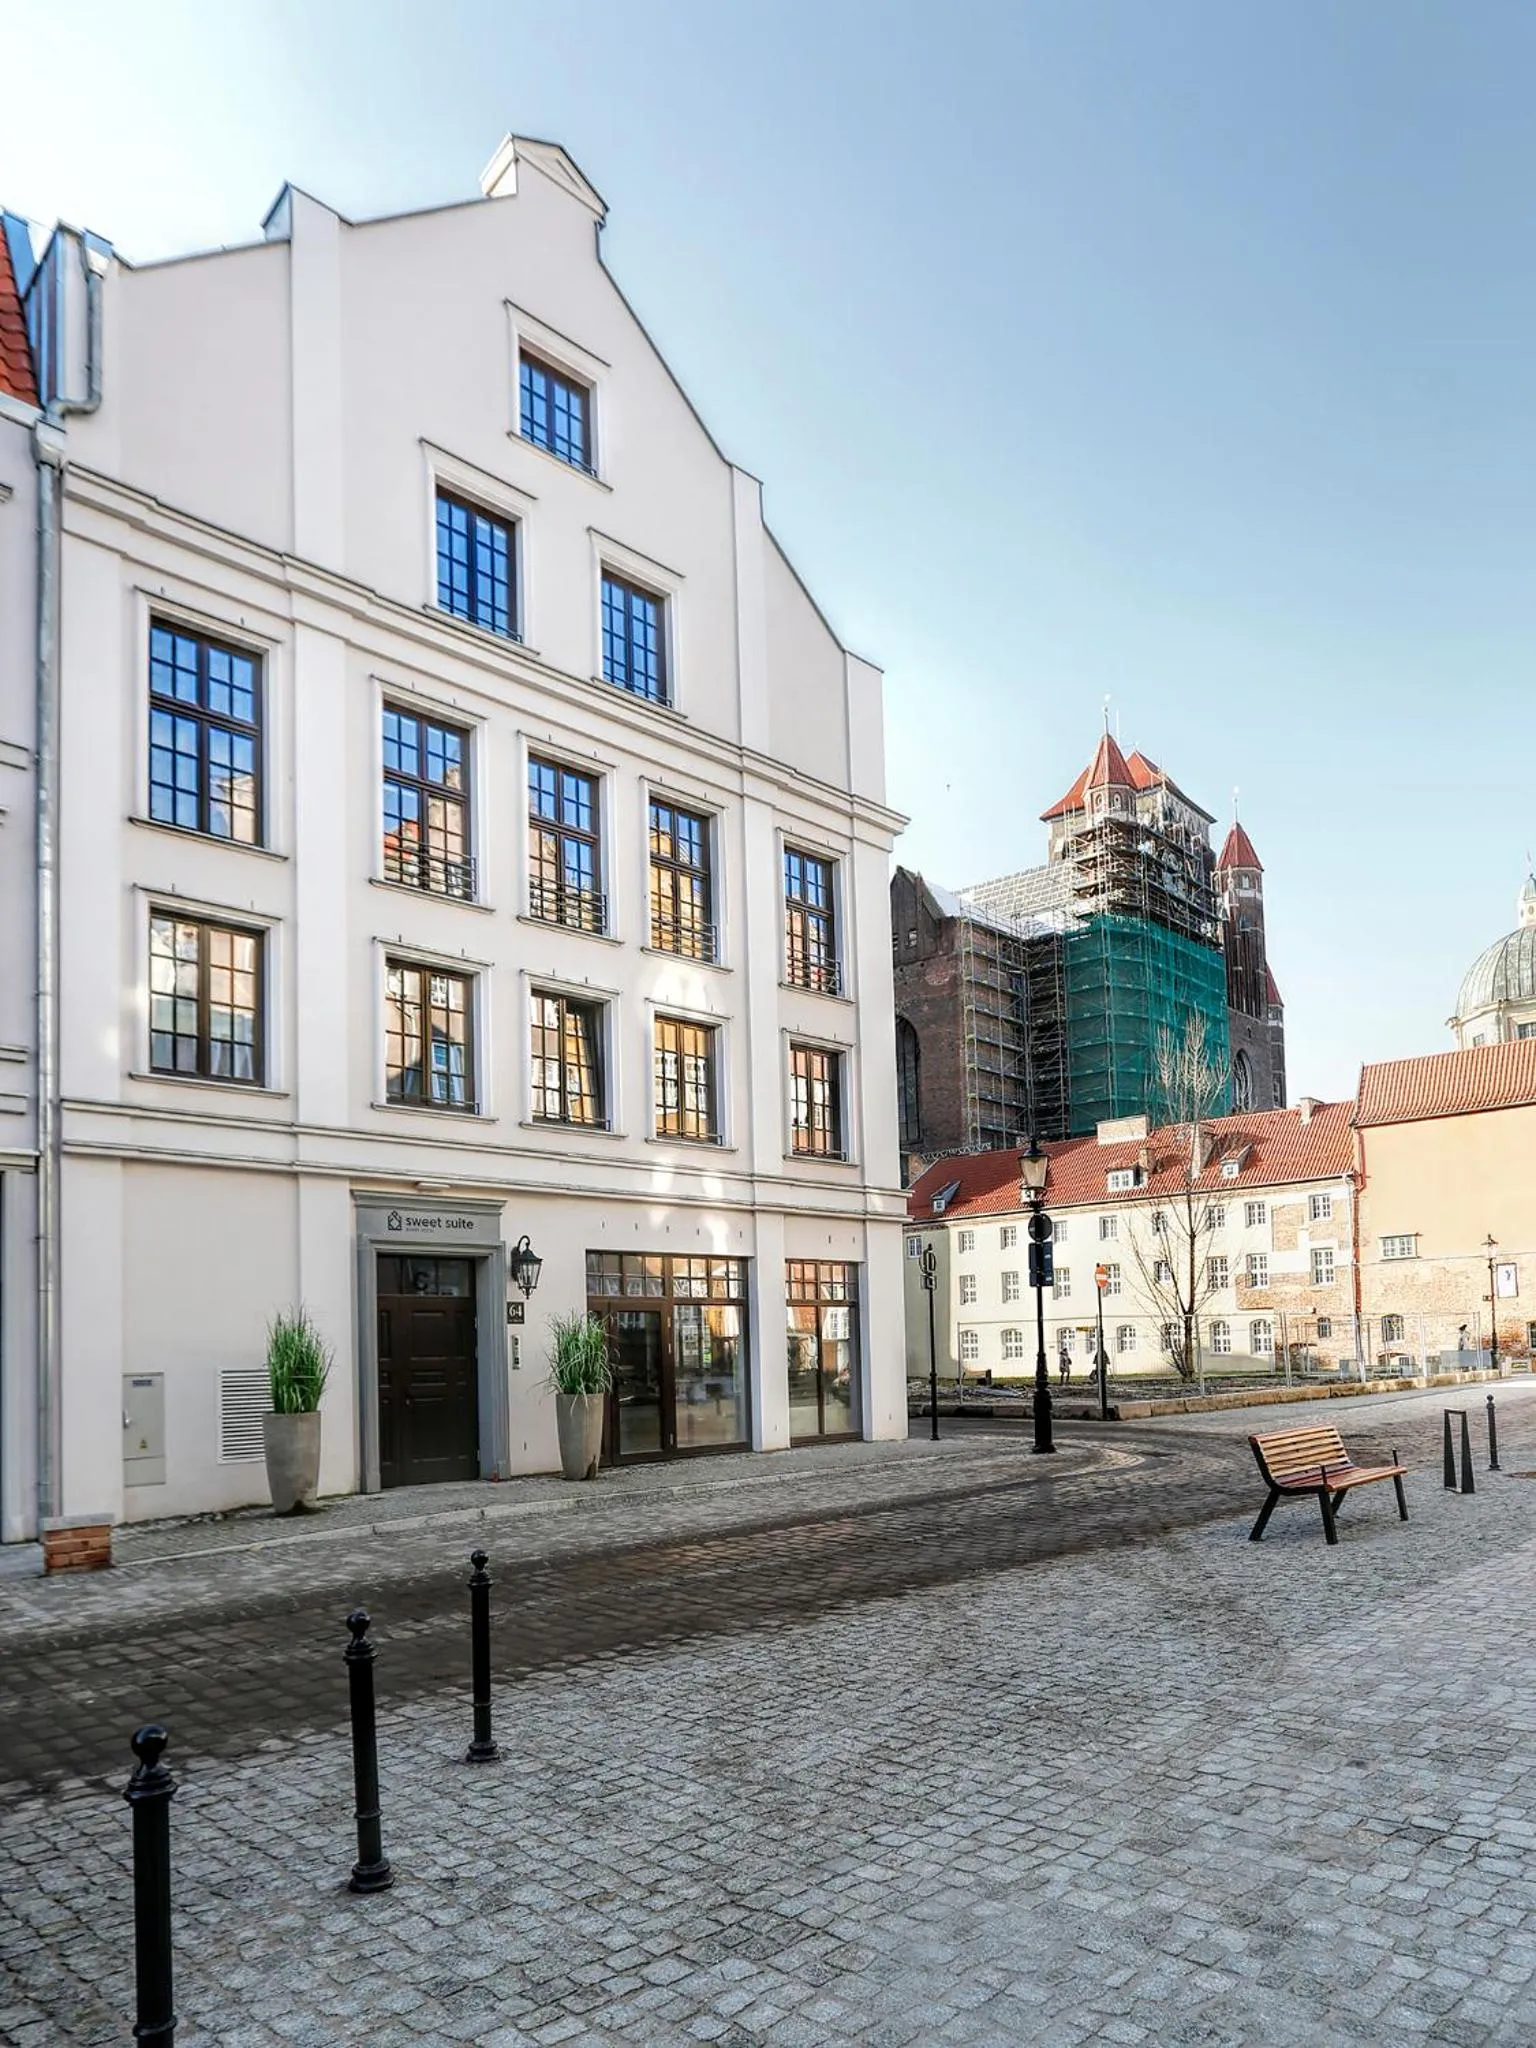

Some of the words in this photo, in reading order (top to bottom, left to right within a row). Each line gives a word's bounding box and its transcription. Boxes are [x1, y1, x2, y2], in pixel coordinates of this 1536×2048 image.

[406, 1217, 441, 1228] sweet
[445, 1217, 474, 1229] suite
[509, 1304, 522, 1317] 64
